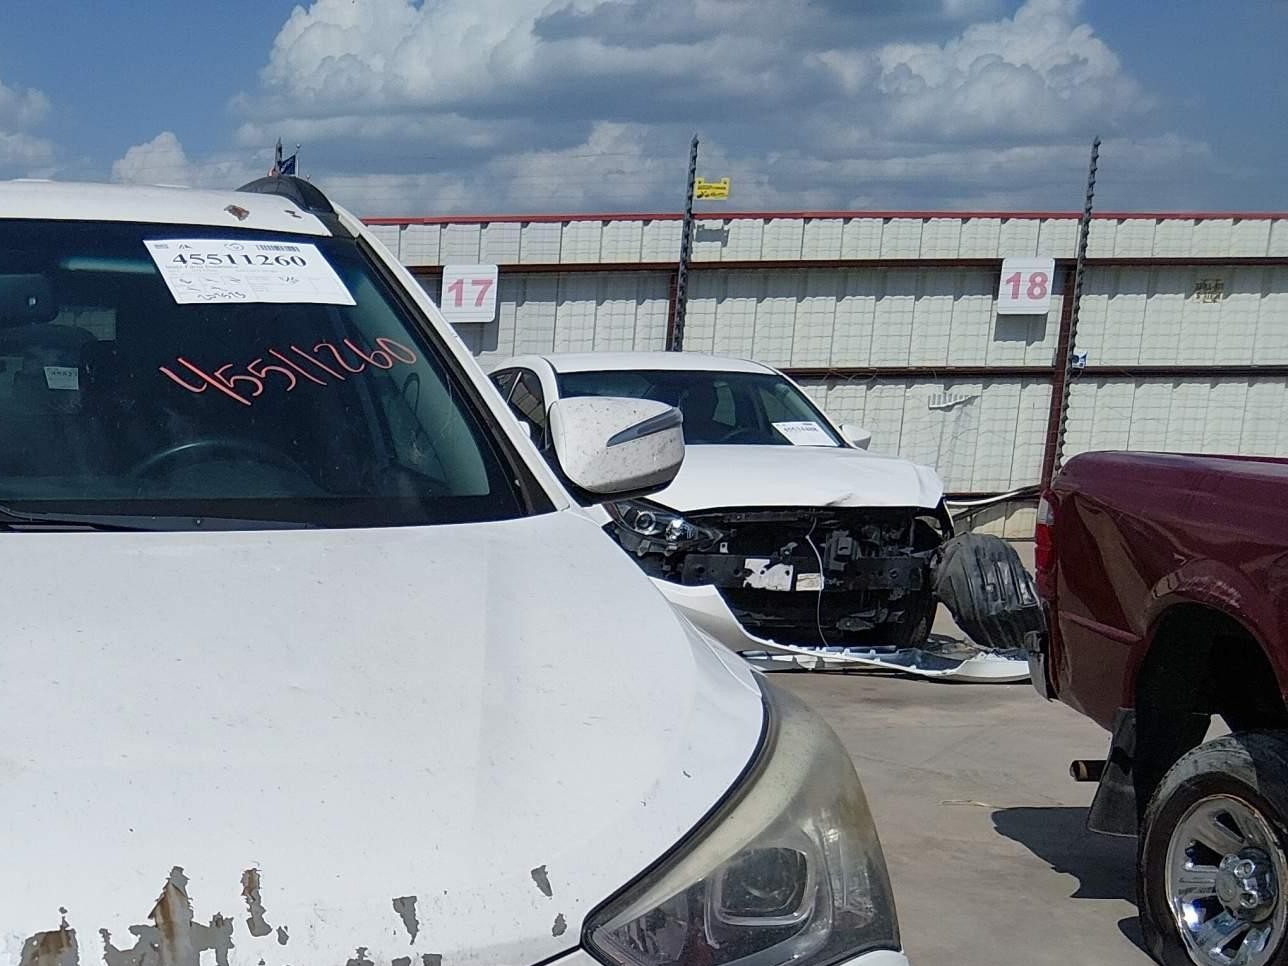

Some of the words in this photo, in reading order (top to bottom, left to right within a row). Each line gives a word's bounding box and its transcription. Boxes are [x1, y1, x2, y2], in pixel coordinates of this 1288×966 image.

[172, 252, 308, 268] 45511260
[447, 278, 494, 308] 17
[1005, 271, 1049, 300] 18
[158, 336, 418, 407] 45511260
